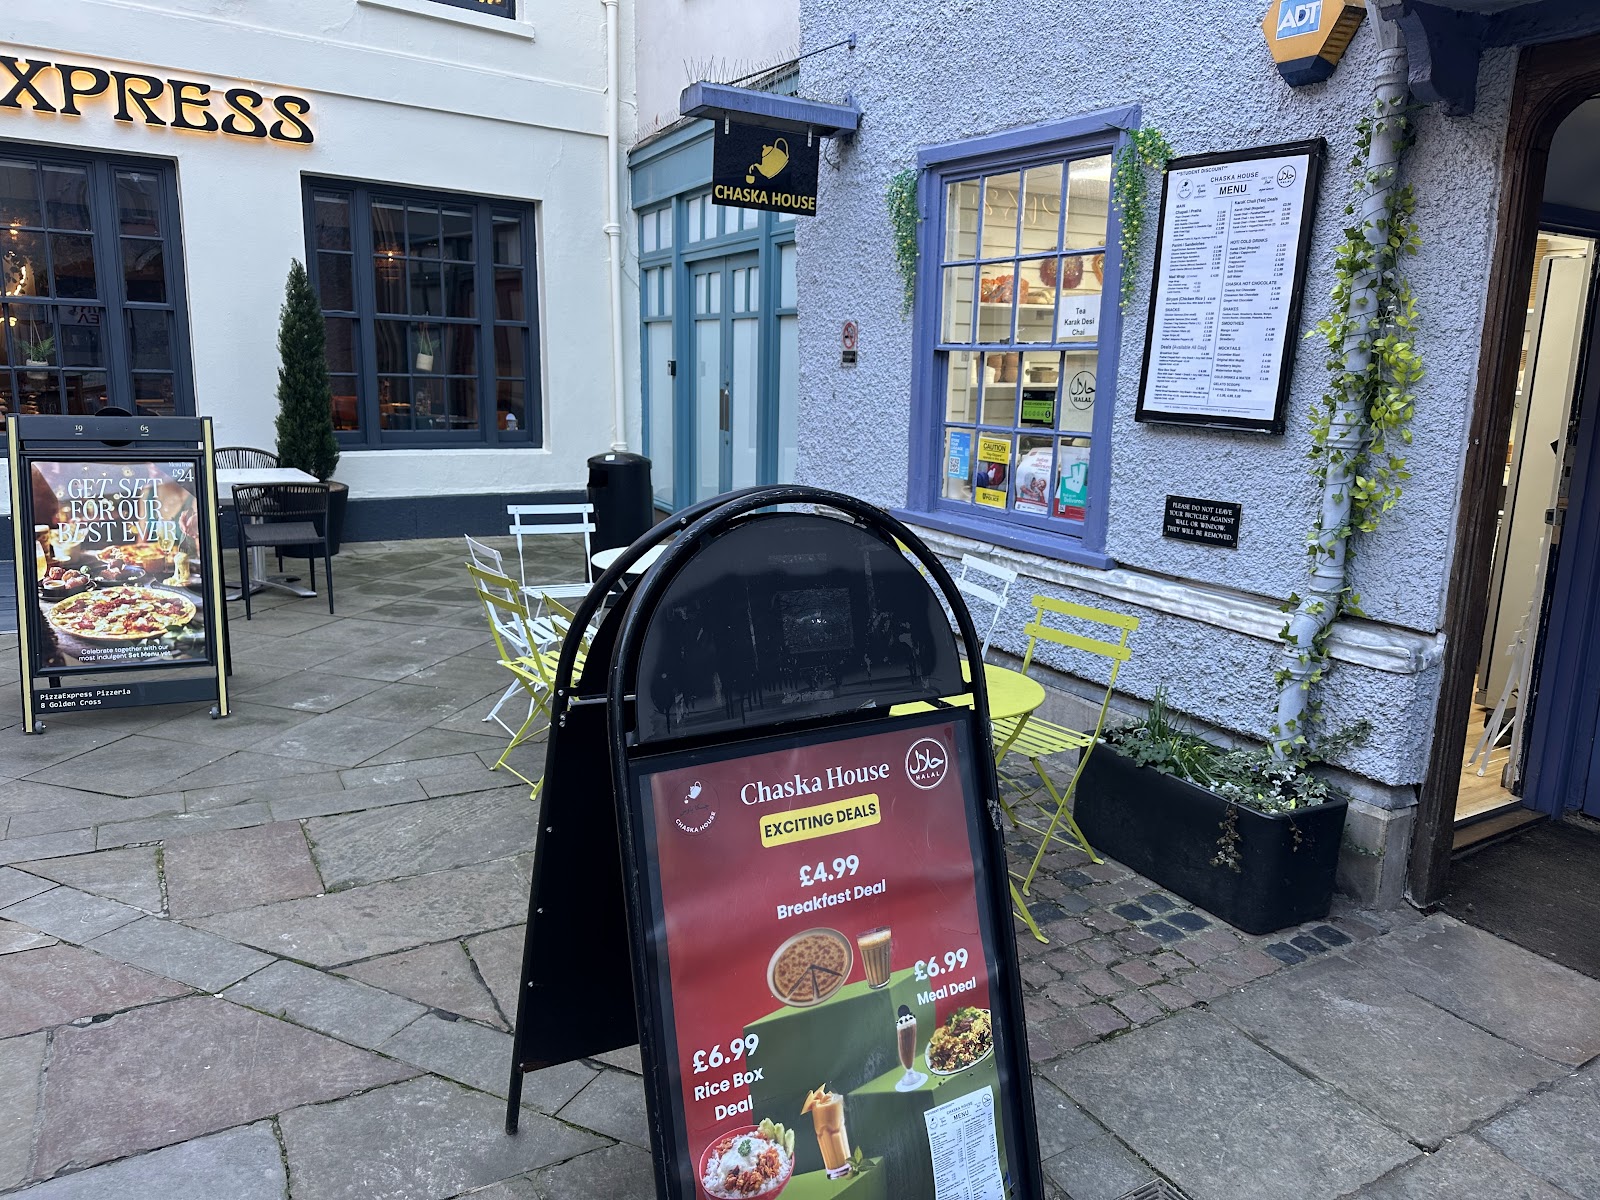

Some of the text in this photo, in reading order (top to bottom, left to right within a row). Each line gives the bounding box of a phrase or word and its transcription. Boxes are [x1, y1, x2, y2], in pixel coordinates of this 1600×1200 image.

[1277, 1, 1321, 31] ADT
[0, 56, 314, 144] XPRESS
[1210, 171, 1259, 183] CHASKA HOUSE
[715, 185, 816, 210] CHASKA HOUSE
[1219, 184, 1248, 195] MENU
[140, 424, 149, 433] 65
[983, 443, 1006, 452] CAUTION
[172, 469, 194, 482] £24
[68, 478, 163, 499] GET SET
[70, 500, 164, 520] FOR OUR
[1185, 512, 1209, 520] BICYCLES
[1210, 516, 1235, 524] AGAINST
[57, 520, 178, 542] BEST EVER
[1204, 532, 1233, 540] REMOVED.
[40, 692, 92, 700] PizzaExpress
[910, 748, 944, 774] حلال
[740, 762, 890, 805] Chaska House
[916, 771, 940, 780] HALAL
[675, 811, 716, 832] CHASKA HOUSE
[764, 803, 877, 838] EXCITING DEALS
[800, 854, 860, 887] £4.99
[777, 879, 886, 920] Breakfast Deal
[914, 948, 968, 981] £6.99
[917, 977, 976, 1006] Meal Deal
[692, 1034, 759, 1074] £6.99
[694, 1068, 764, 1101] Rice Box
[715, 1094, 753, 1120] Deal
[953, 1110, 969, 1120] MENU
